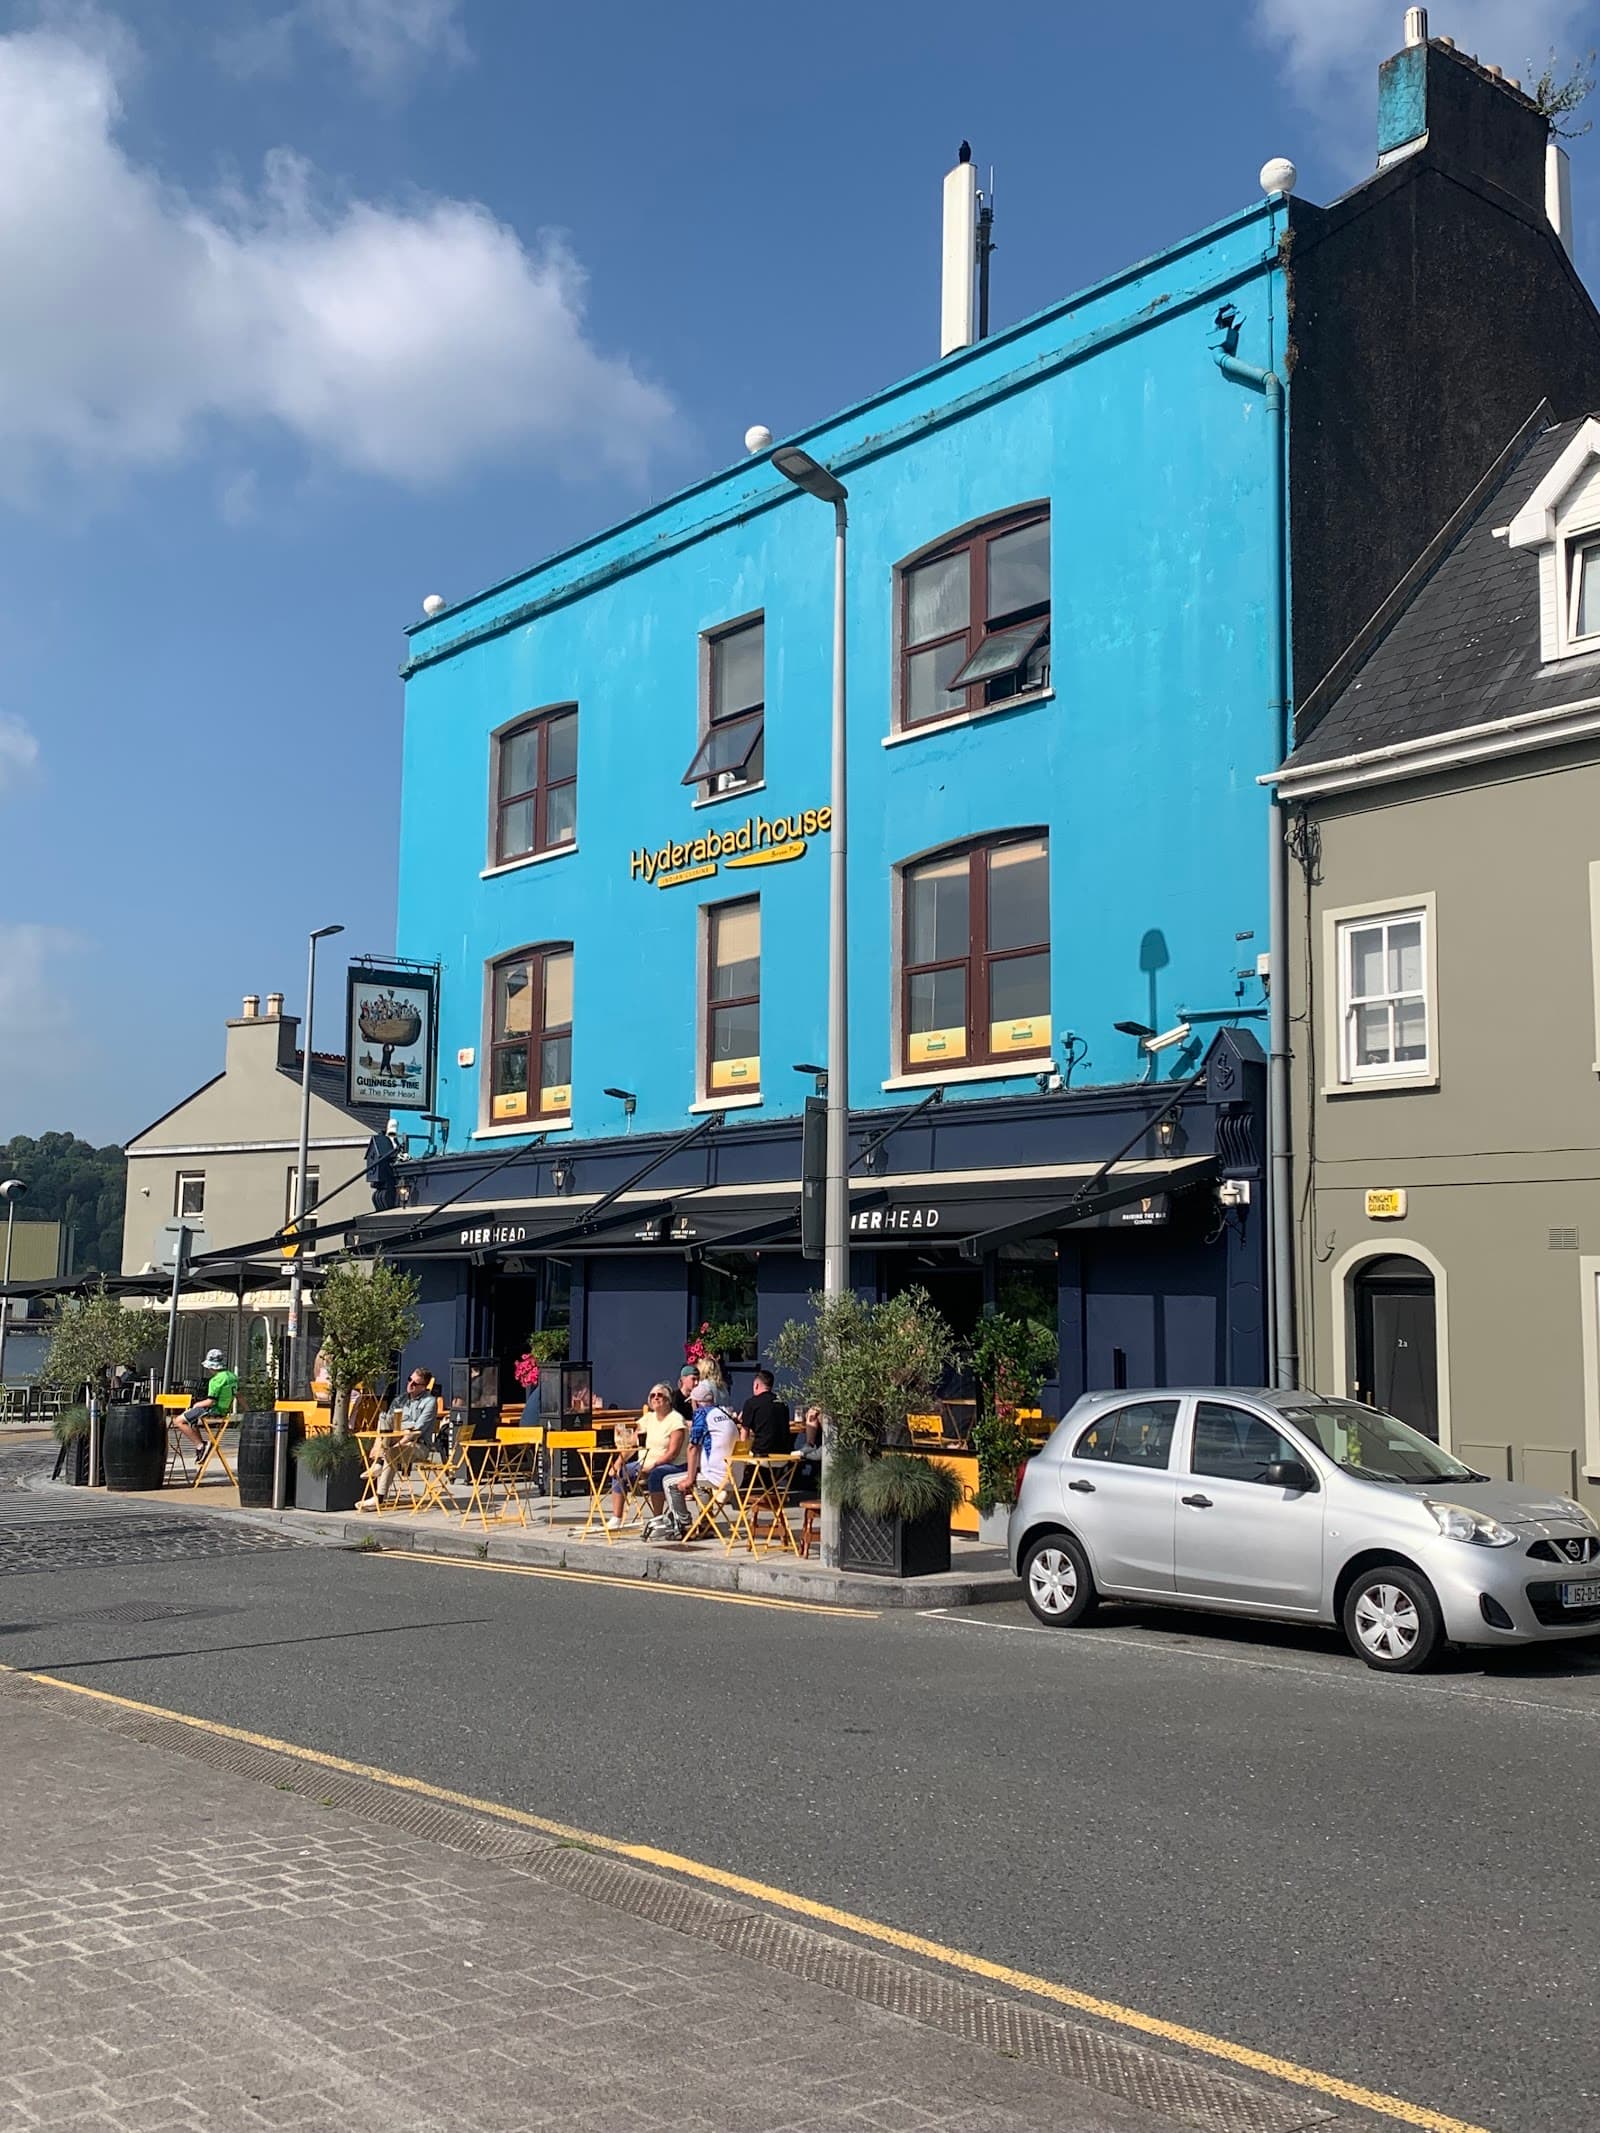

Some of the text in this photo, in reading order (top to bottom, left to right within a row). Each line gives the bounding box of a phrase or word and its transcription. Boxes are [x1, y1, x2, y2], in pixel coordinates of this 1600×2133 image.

[630, 806, 832, 883] Hyderabad house
[850, 1209, 939, 1230] IERHEAD
[460, 1227, 526, 1245] PIERHEAD
